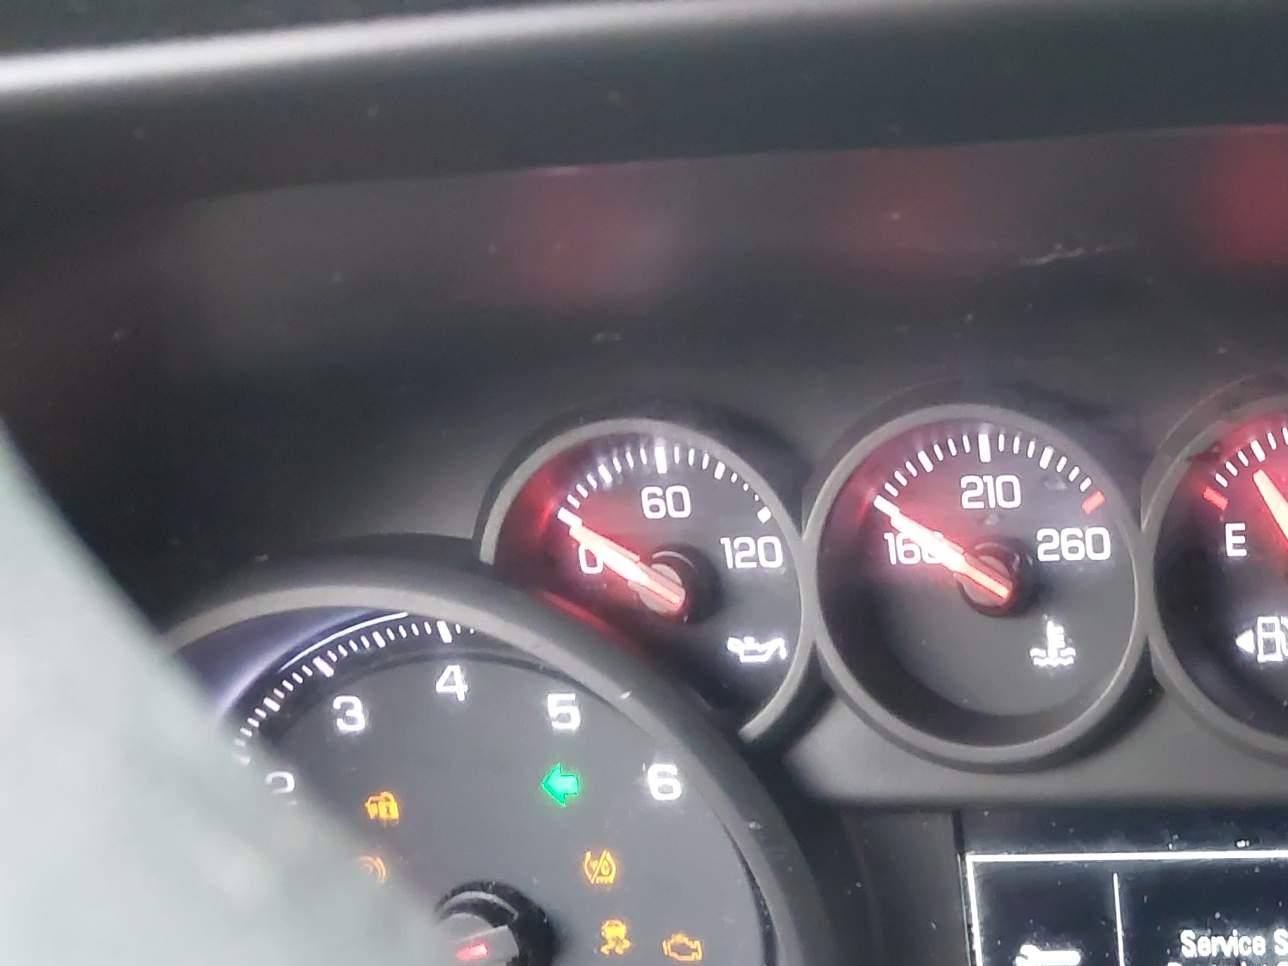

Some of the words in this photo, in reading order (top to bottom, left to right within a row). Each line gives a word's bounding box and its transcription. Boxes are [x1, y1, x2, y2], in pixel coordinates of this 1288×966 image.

[641, 485, 690, 518] 60
[960, 476, 1021, 509] 210
[721, 536, 783, 570] 120
[1037, 527, 1110, 562] 260
[1225, 523, 1246, 556] E
[436, 665, 468, 702] 4
[332, 695, 366, 734] 3
[547, 693, 581, 731] 5
[647, 764, 682, 801] 6
[1180, 929, 1267, 957] Service
